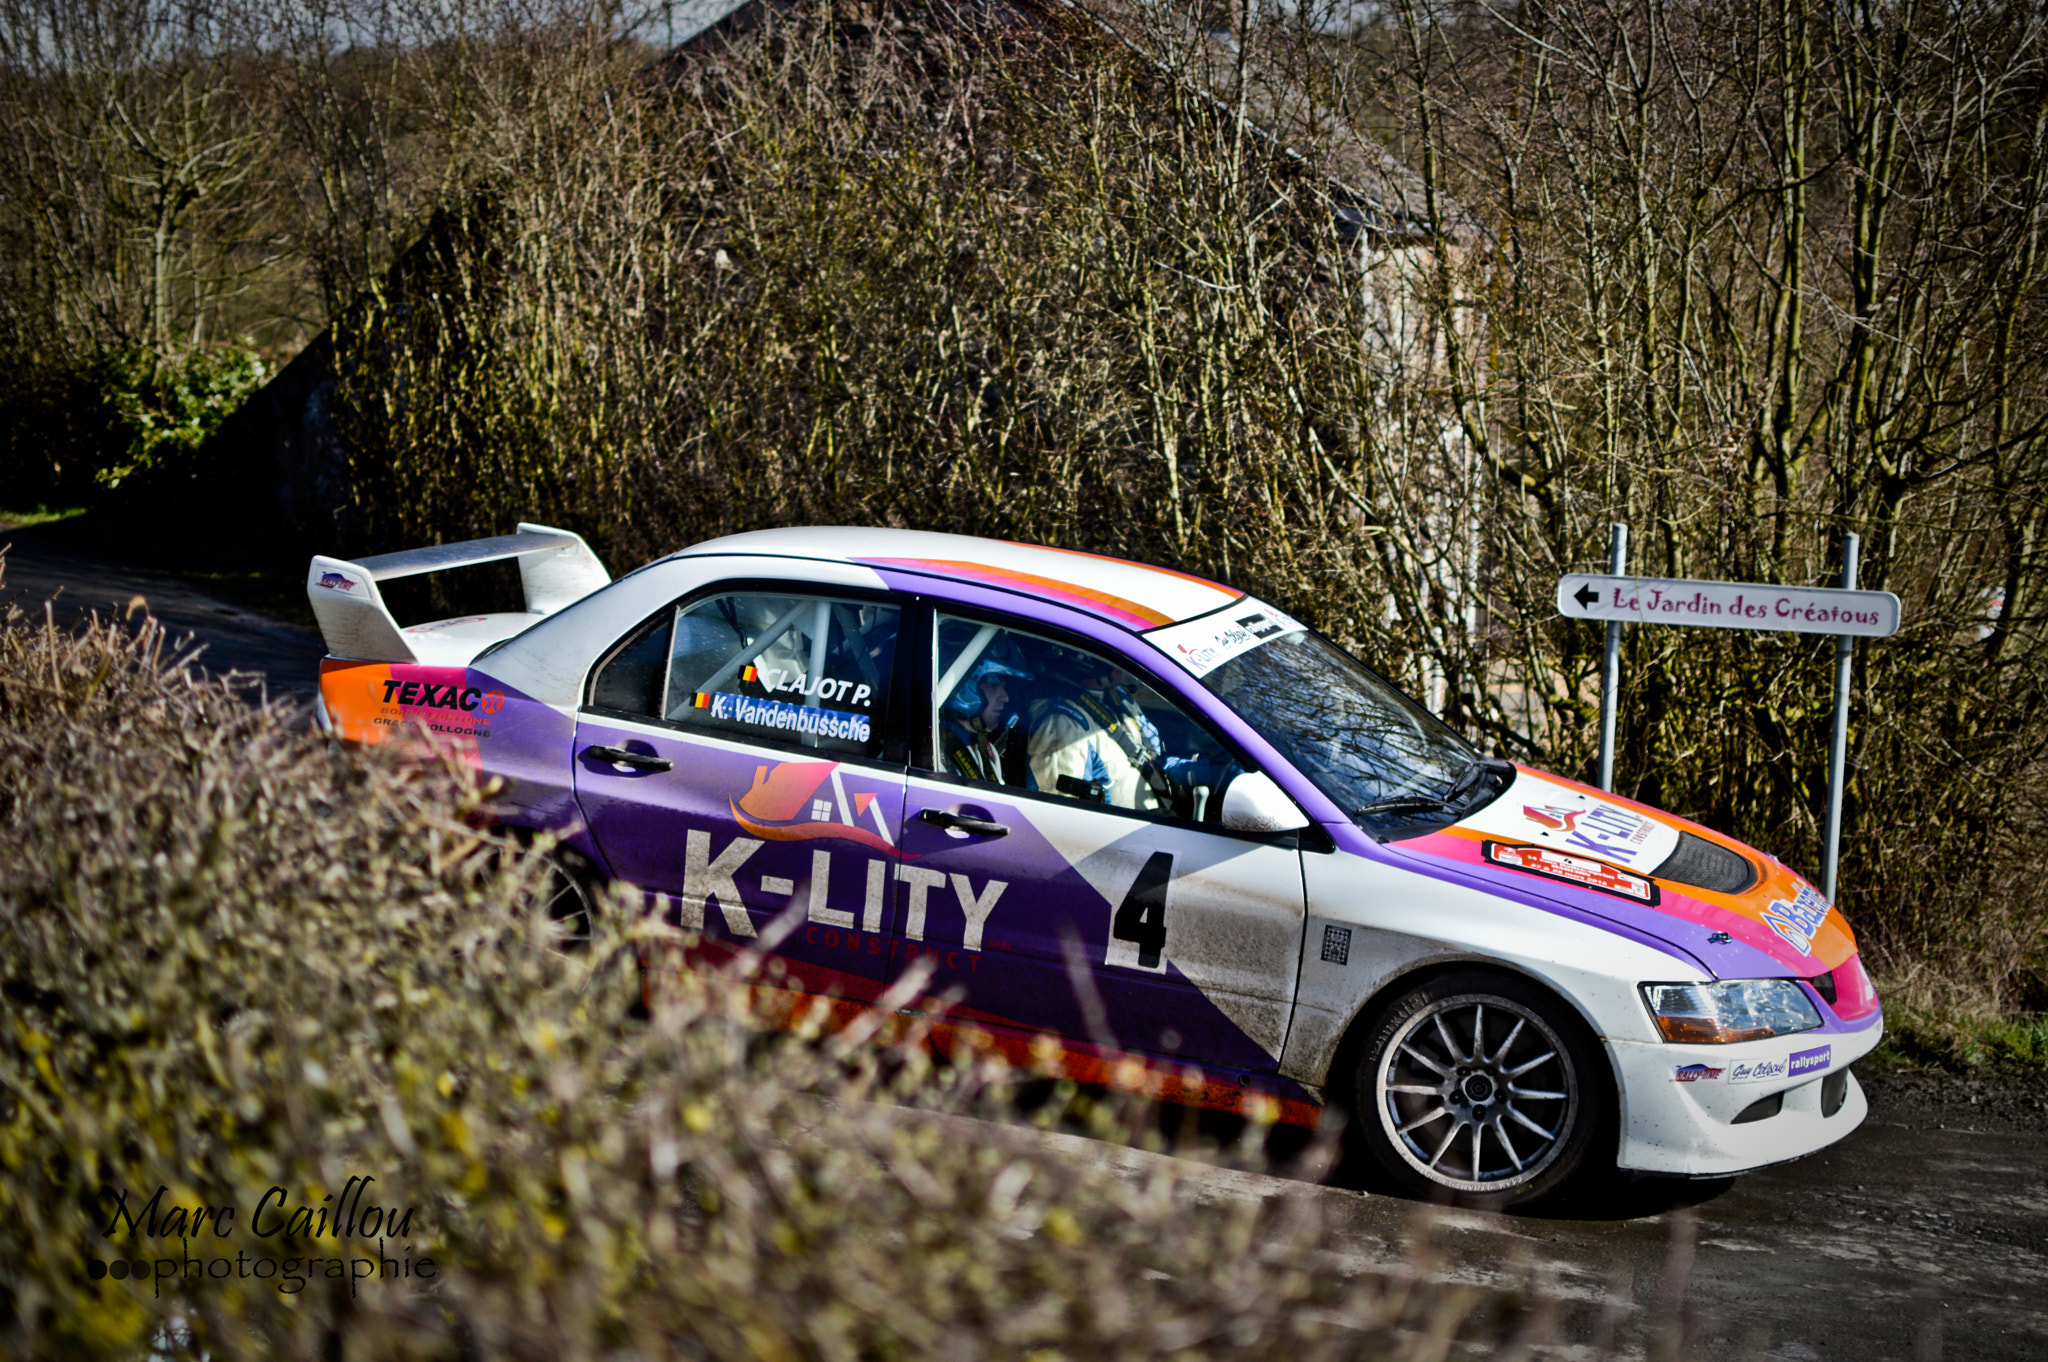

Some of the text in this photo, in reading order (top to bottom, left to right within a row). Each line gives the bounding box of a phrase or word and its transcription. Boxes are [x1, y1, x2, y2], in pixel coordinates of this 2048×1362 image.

[1614, 588, 1880, 626] Le Jardin des Créatous
[763, 668, 872, 708] CLAJOT P.
[734, 698, 871, 743] Vandenbussche
[1565, 804, 1644, 864] K-LITY
[680, 829, 1009, 952] K-LITY
[1113, 851, 1173, 969] 4
[806, 927, 982, 973] CONSTRUCT
[1732, 1064, 1753, 1080] Guy
[1791, 1051, 1831, 1070] rallysport
